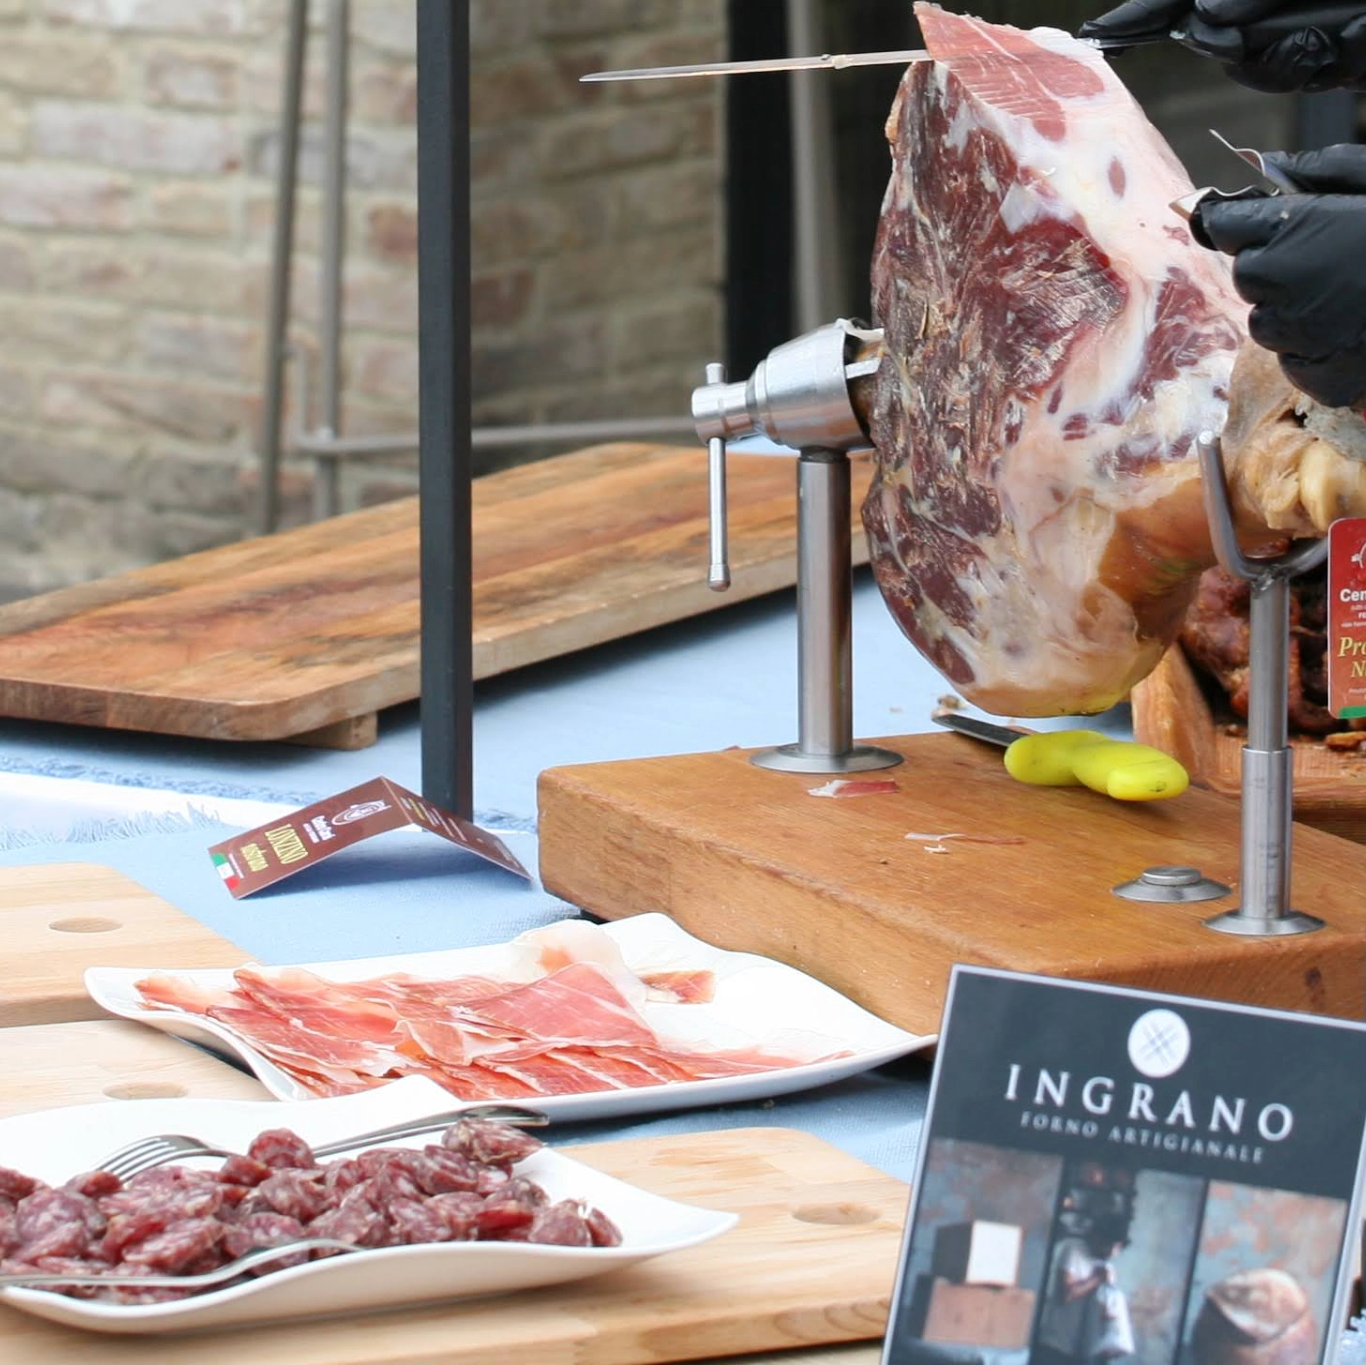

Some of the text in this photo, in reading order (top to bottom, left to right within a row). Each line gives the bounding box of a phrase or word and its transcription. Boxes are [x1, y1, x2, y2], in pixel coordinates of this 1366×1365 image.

[1004, 1063, 1294, 1142] INGRANO
[1020, 1111, 1265, 1165] FORNO ARTIGIANALE
